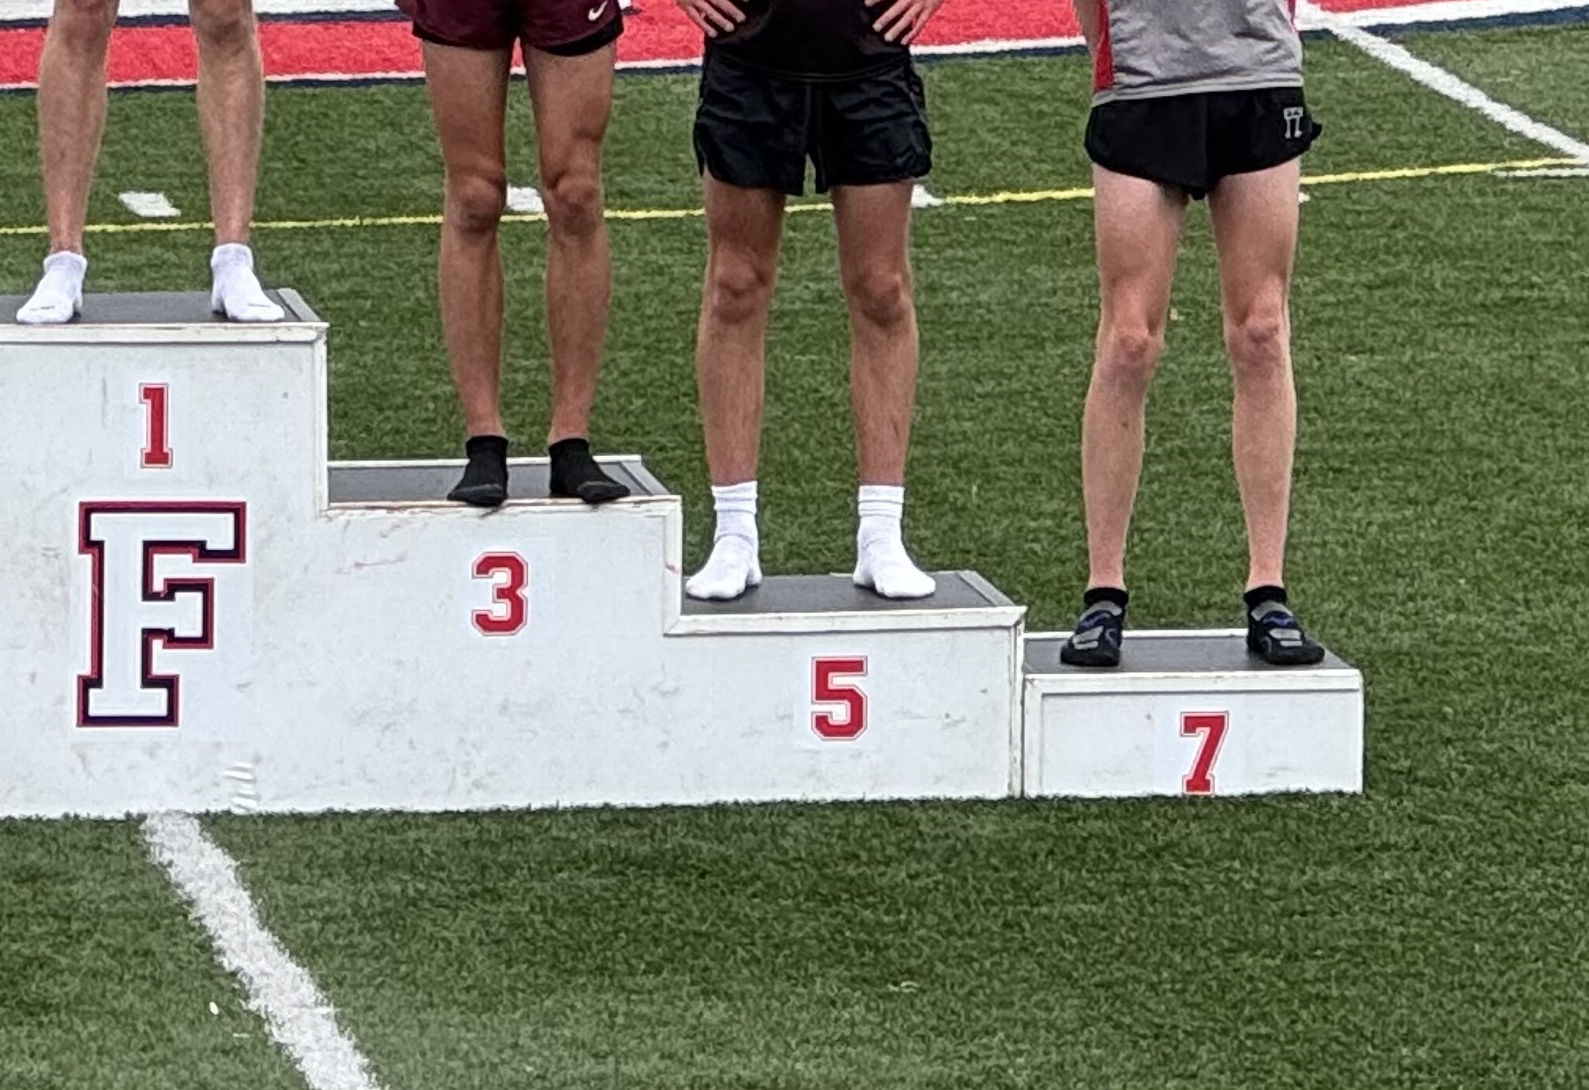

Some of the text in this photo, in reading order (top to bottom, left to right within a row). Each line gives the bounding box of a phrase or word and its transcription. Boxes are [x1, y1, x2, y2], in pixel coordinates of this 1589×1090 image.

[139, 383, 173, 468] 1
[76, 501, 247, 728] F
[471, 551, 528, 636] 3
[811, 656, 868, 741] 5
[1179, 711, 1230, 795] 7
